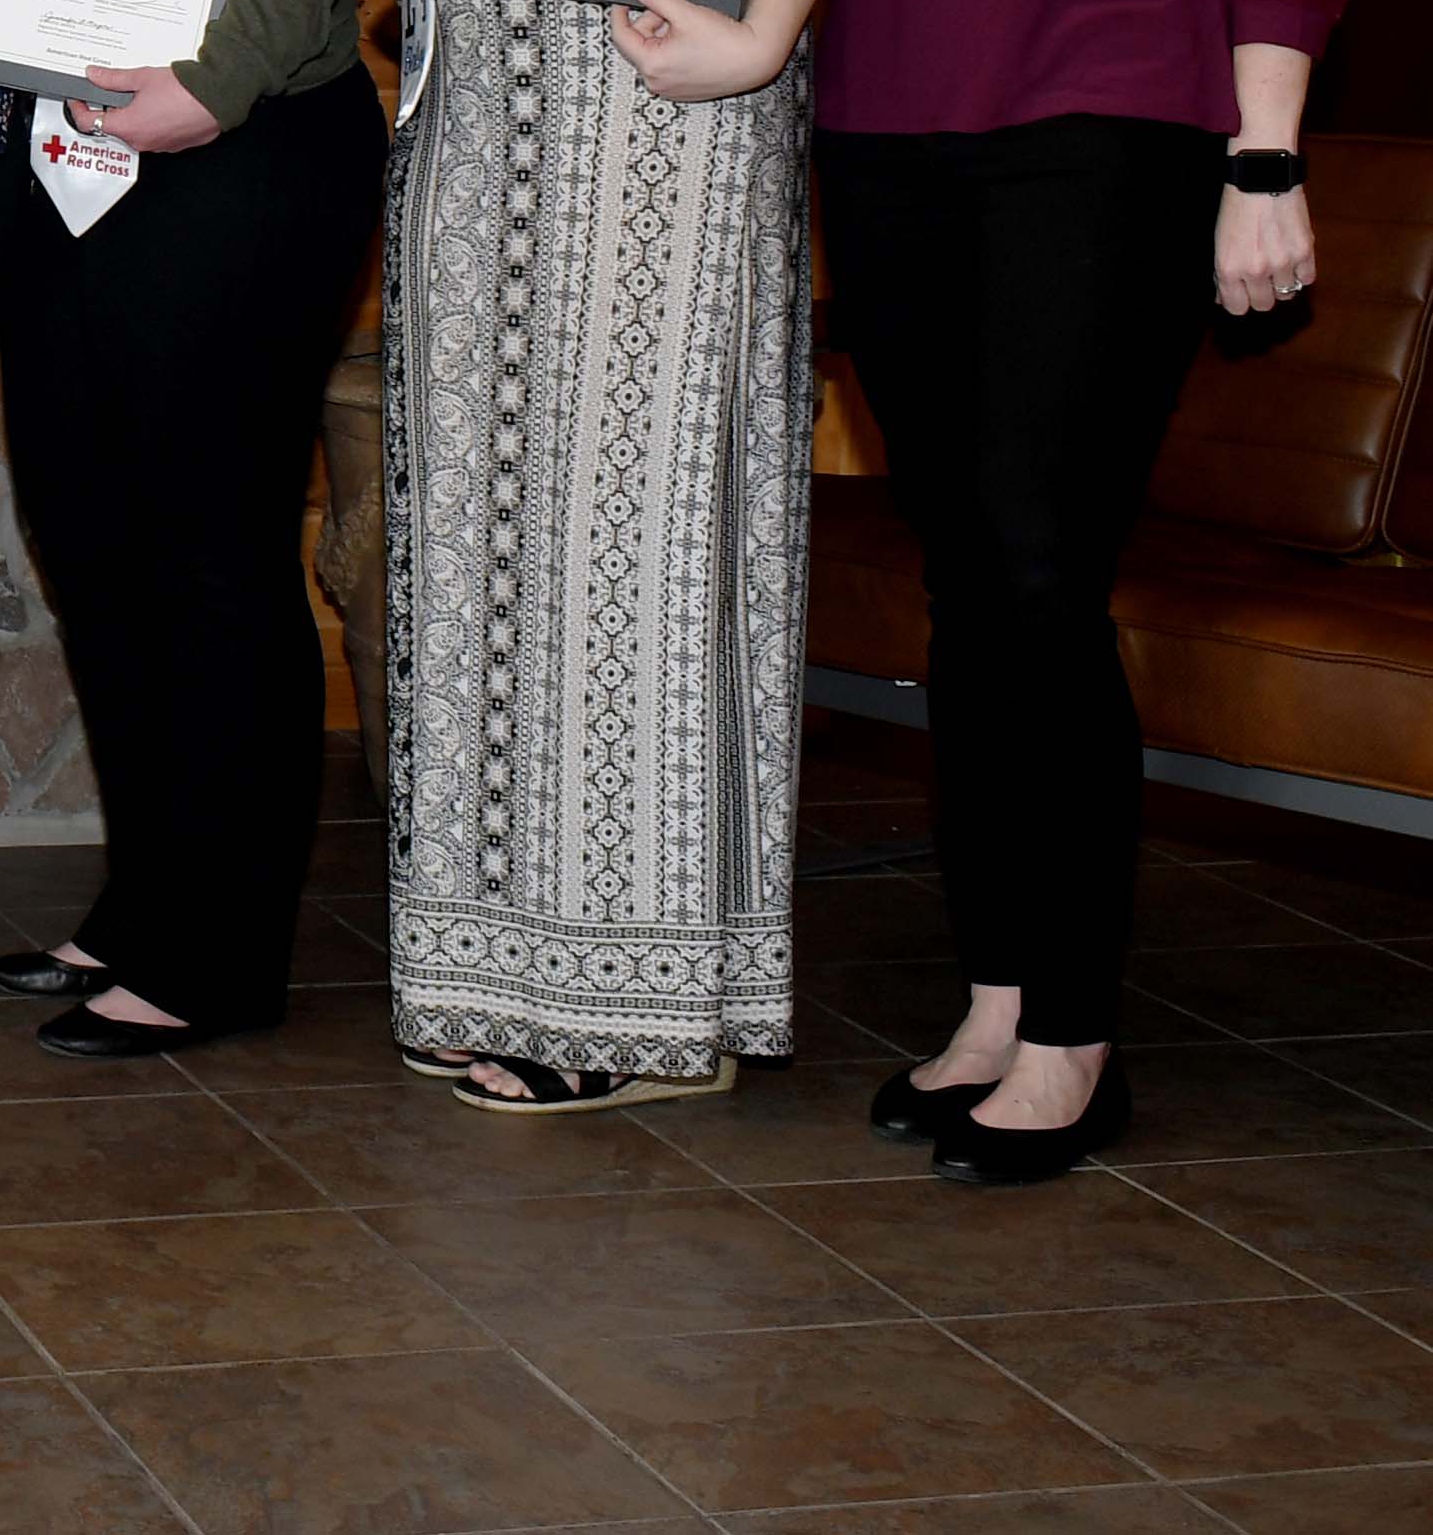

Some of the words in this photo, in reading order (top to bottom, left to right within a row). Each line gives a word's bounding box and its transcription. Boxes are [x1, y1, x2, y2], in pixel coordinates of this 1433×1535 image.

[70, 140, 131, 164] American
[66, 154, 92, 170] Red
[95, 160, 129, 178] Cross
